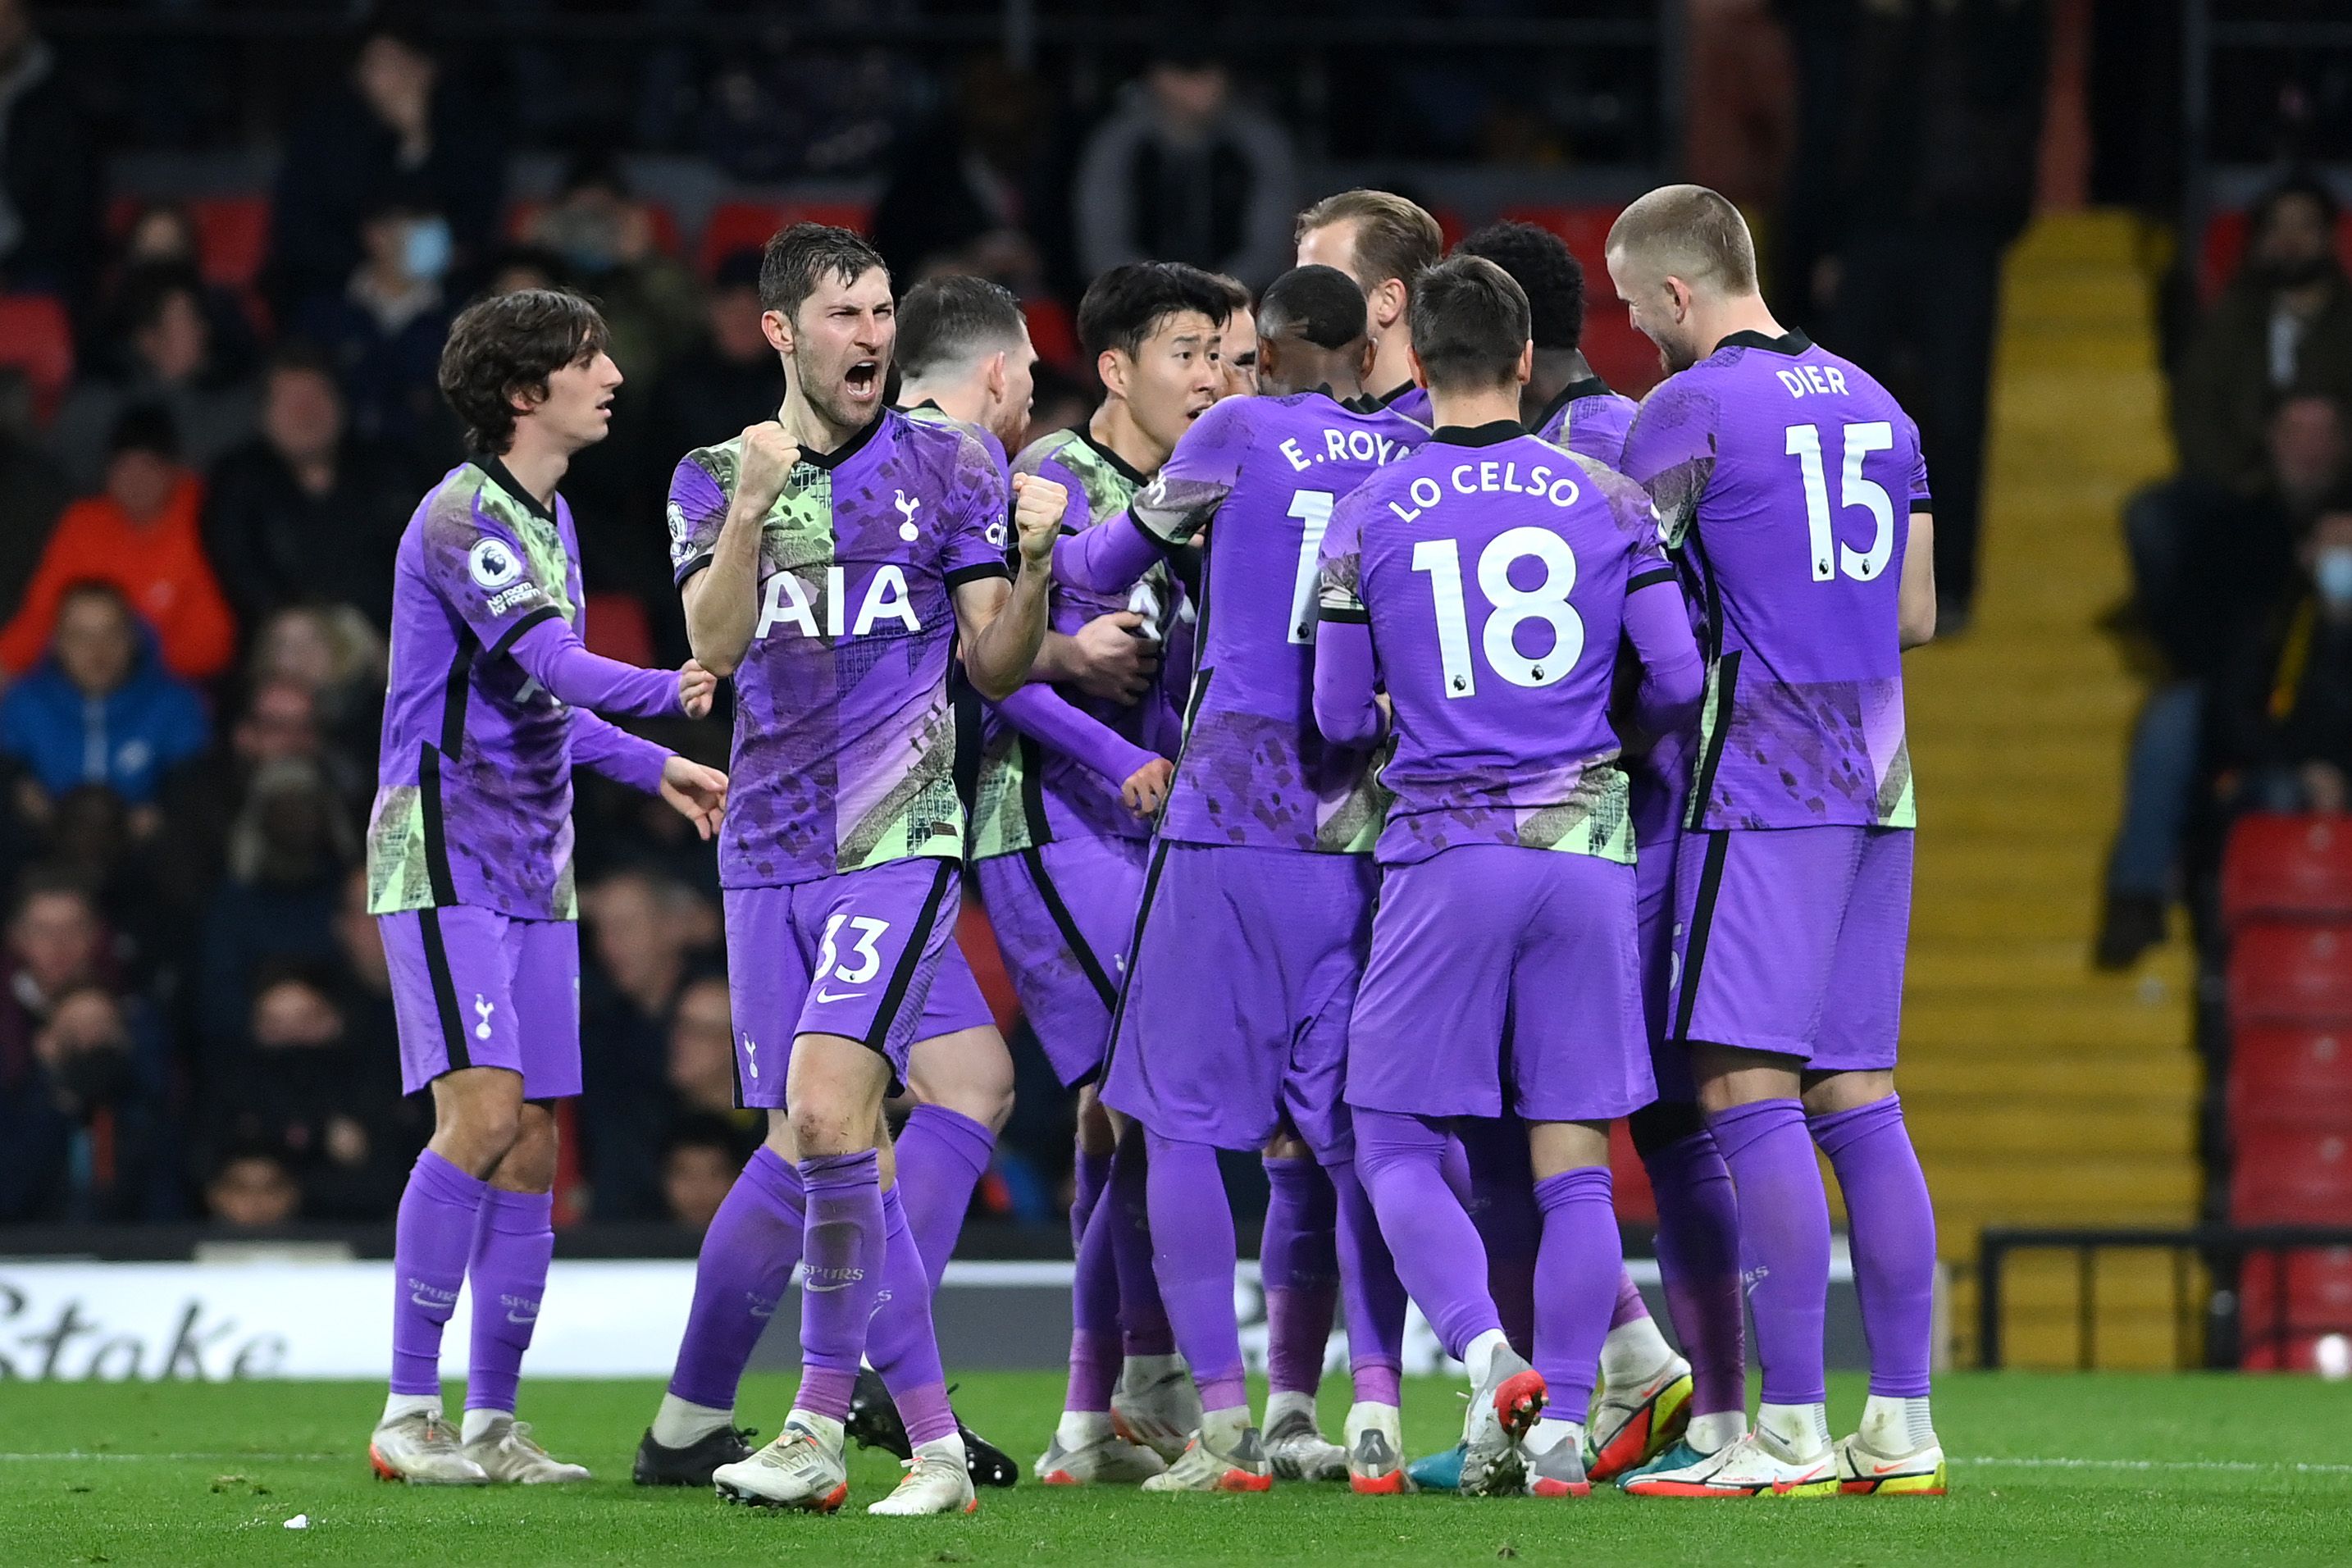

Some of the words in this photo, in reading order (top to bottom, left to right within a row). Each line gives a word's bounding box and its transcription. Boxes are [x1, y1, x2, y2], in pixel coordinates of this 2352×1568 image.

[1775, 366, 1850, 399] DIER
[1388, 477, 1443, 524] LO
[1452, 461, 1580, 508] CELSO
[1785, 422, 1894, 582] 15
[486, 594, 504, 607] No
[502, 581, 533, 599] room
[505, 588, 541, 607] racism
[755, 564, 922, 639] AIA
[1411, 526, 1584, 699] 18
[802, 1264, 865, 1281] SPURS
